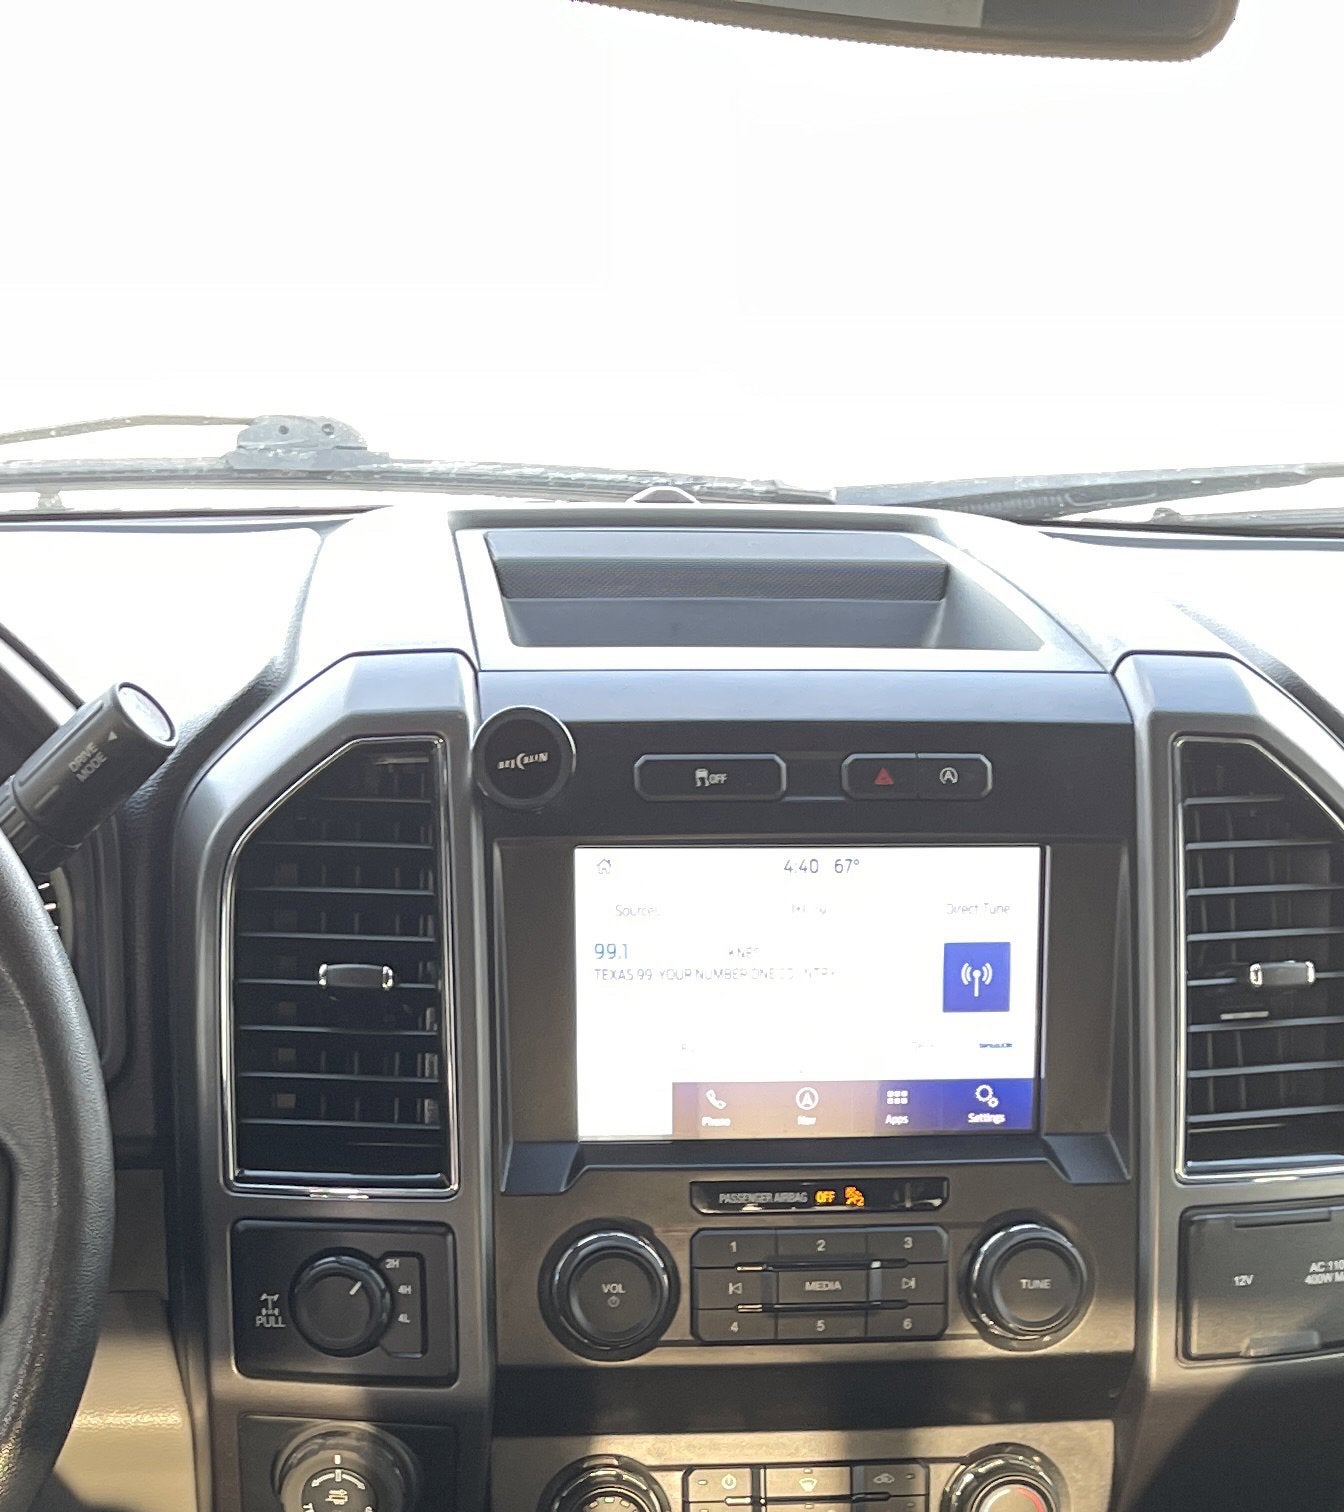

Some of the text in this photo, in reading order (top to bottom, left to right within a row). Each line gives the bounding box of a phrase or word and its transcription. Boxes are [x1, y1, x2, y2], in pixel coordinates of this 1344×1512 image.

[76, 751, 107, 783] MODE
[708, 773, 727, 784] OFF
[783, 858, 819, 873] 4:40
[594, 943, 628, 959] 99.1
[594, 968, 634, 981] TEXAS
[637, 968, 653, 981] 99
[885, 1114, 909, 1126] Apps
[967, 1112, 1006, 1125] Settings
[719, 1190, 835, 1203] PASSENGER AIRBAG OFF
[730, 1242, 737, 1252] 1
[816, 1239, 826, 1251] 2
[903, 1237, 913, 1249] 3
[385, 1258, 400, 1269] 2H
[1309, 1261, 1326, 1273] AC
[804, 1281, 842, 1291] MEDIA
[1020, 1279, 1051, 1289] TUNE
[1233, 1274, 1255, 1287] 12V
[601, 1283, 626, 1293] VOL
[256, 1315, 287, 1328] PULL
[730, 1322, 739, 1333] 4
[816, 1320, 825, 1332] 5
[903, 1318, 912, 1330] 6
